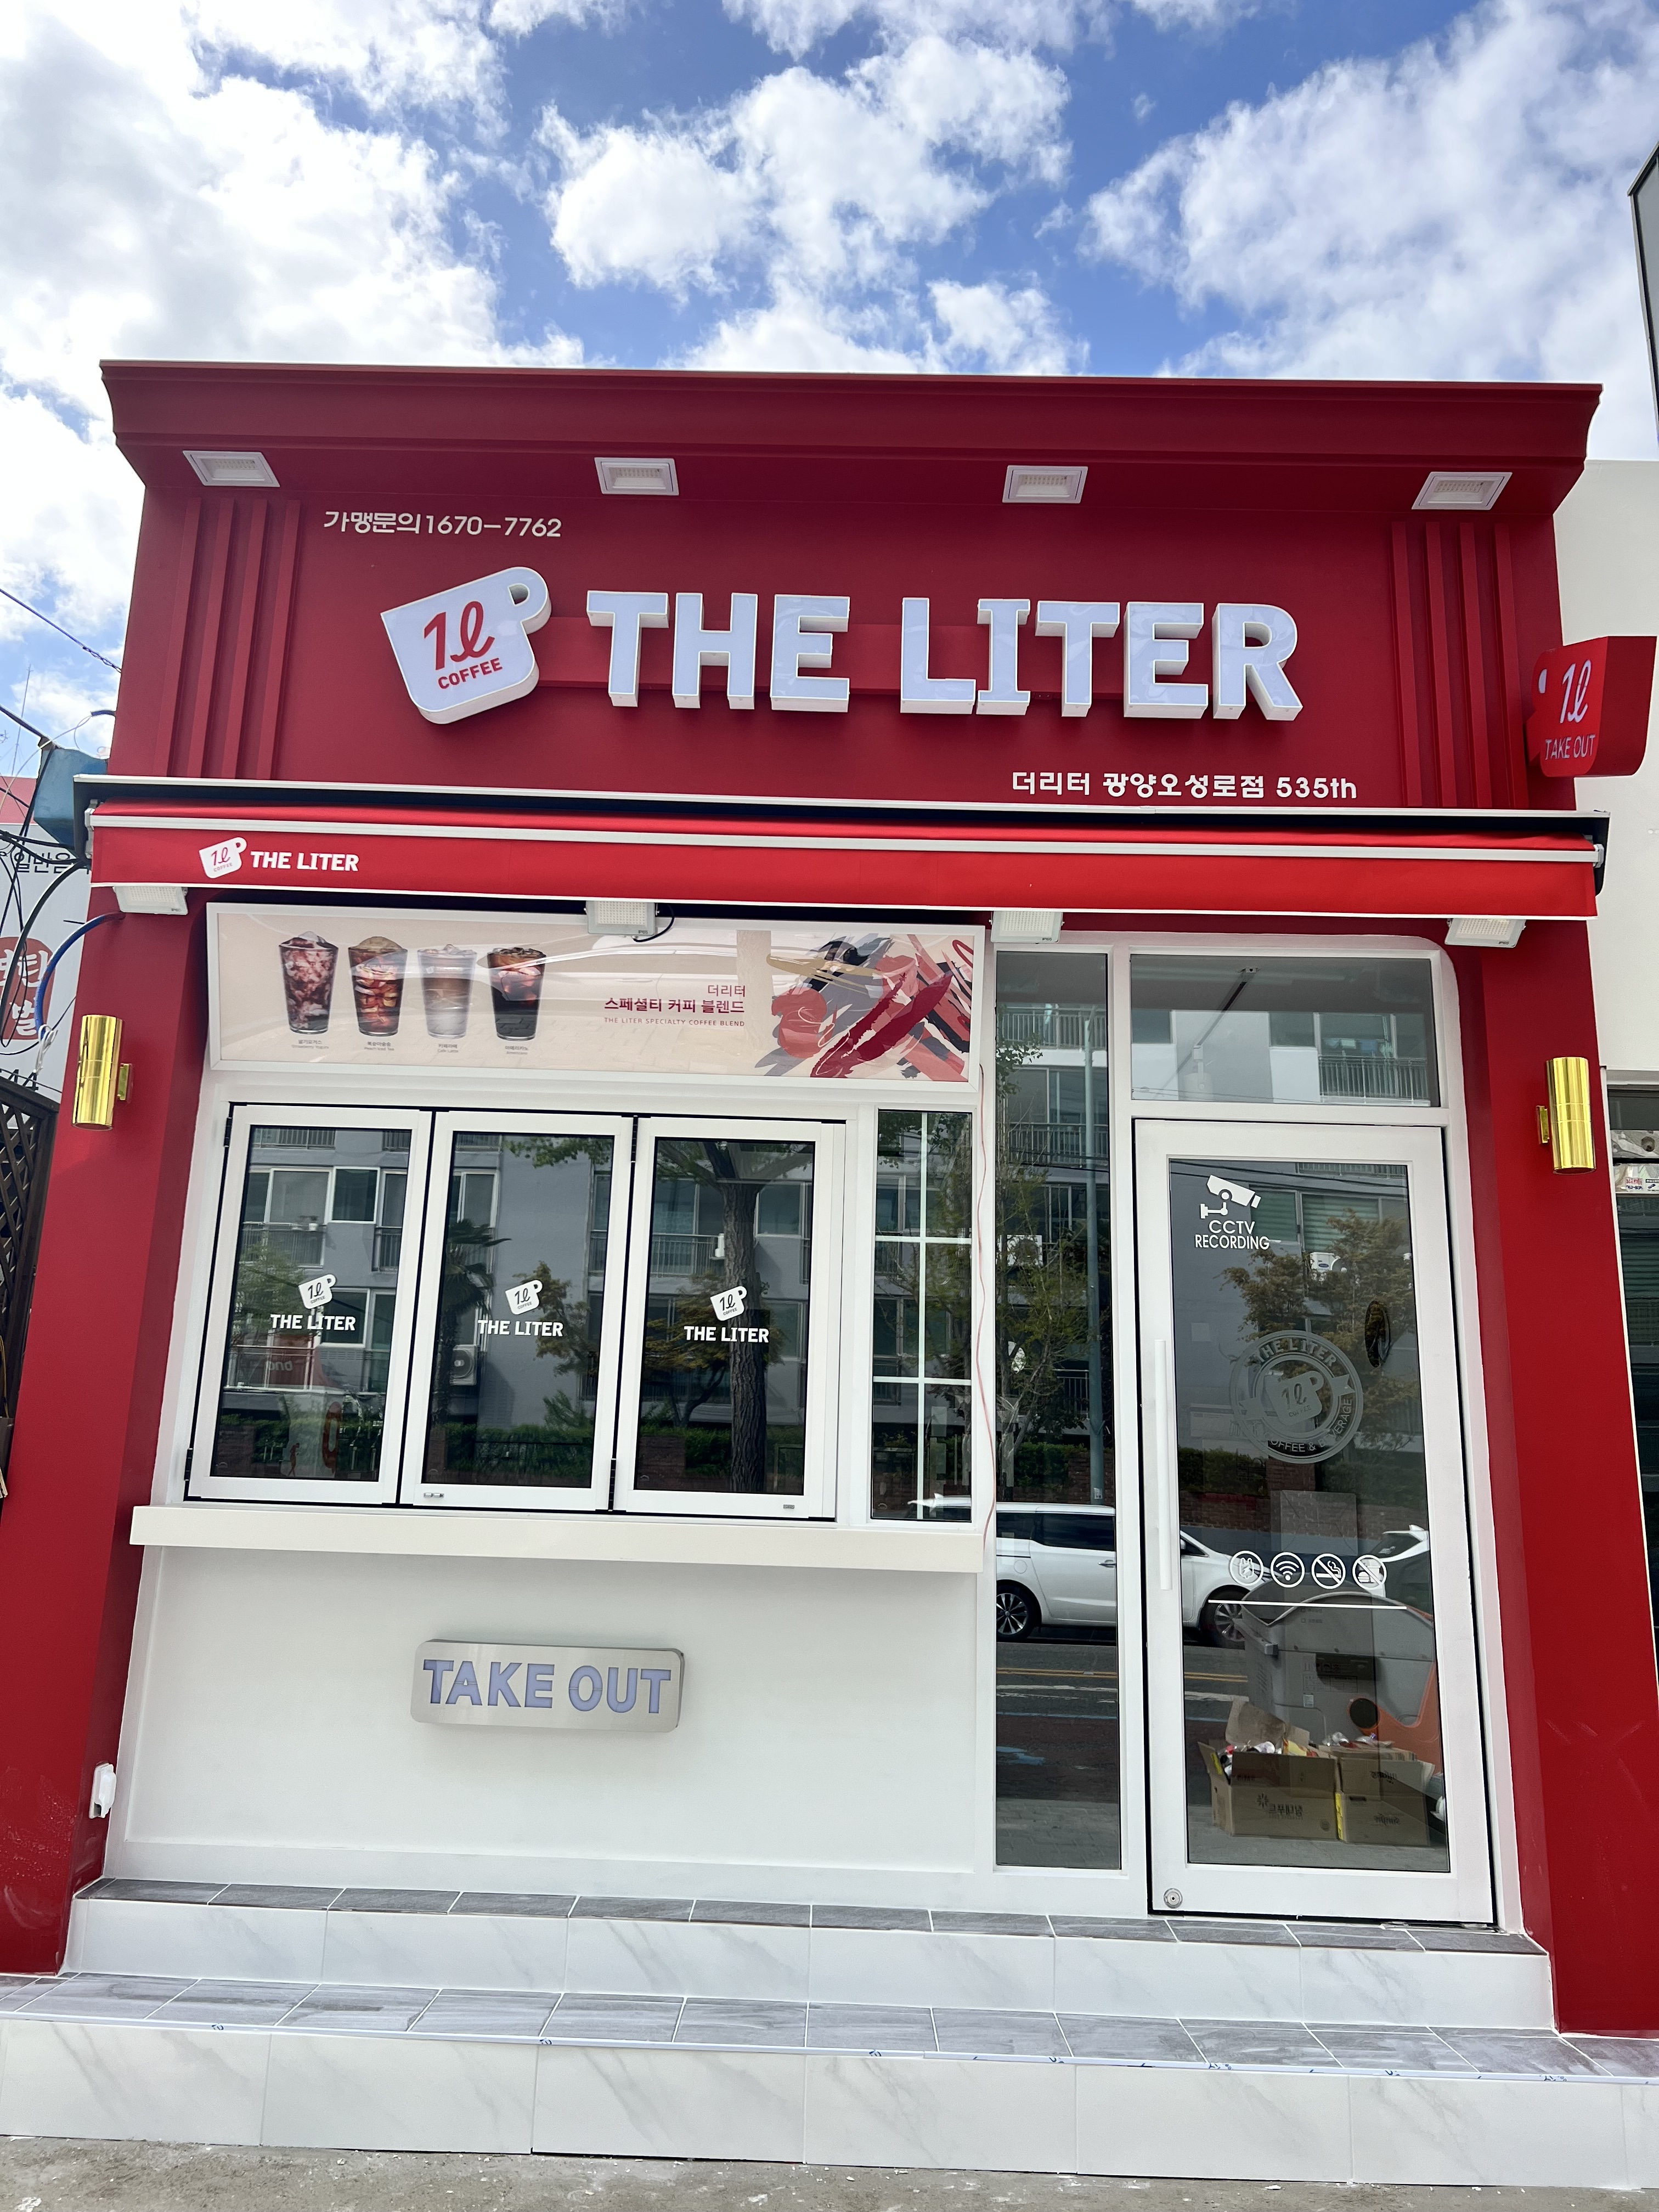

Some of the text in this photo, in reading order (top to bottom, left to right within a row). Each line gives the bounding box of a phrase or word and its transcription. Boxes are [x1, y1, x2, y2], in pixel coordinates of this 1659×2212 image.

[586, 590, 1304, 721] THE LITER
[438, 658, 503, 689] COFFEE
[1545, 735, 1596, 760] TAKE OUT
[1012, 772, 1090, 795] 더리터
[1276, 777, 1357, 799] 535th
[213, 862, 233, 872] COFFEE
[251, 851, 359, 871] THE LITER
[708, 985, 746, 997] 더리터
[605, 998, 745, 1013] 스페셜티 커피 블렌드
[1209, 1220, 1255, 1234] CCTV
[1195, 1234, 1271, 1250] RECORDING
[311, 1296, 326, 1304] COFFEE
[517, 1301, 532, 1310] COFFEE
[723, 1307, 737, 1316] COFFEE
[270, 1314, 356, 1331] THE LITER
[478, 1319, 563, 1336] THE LITER
[684, 1326, 769, 1343] THE LITER
[1254, 1339, 1337, 1367] THE LITER
[1308, 1441, 1316, 1451] &
[423, 1658, 672, 1714] TAKE OUT
